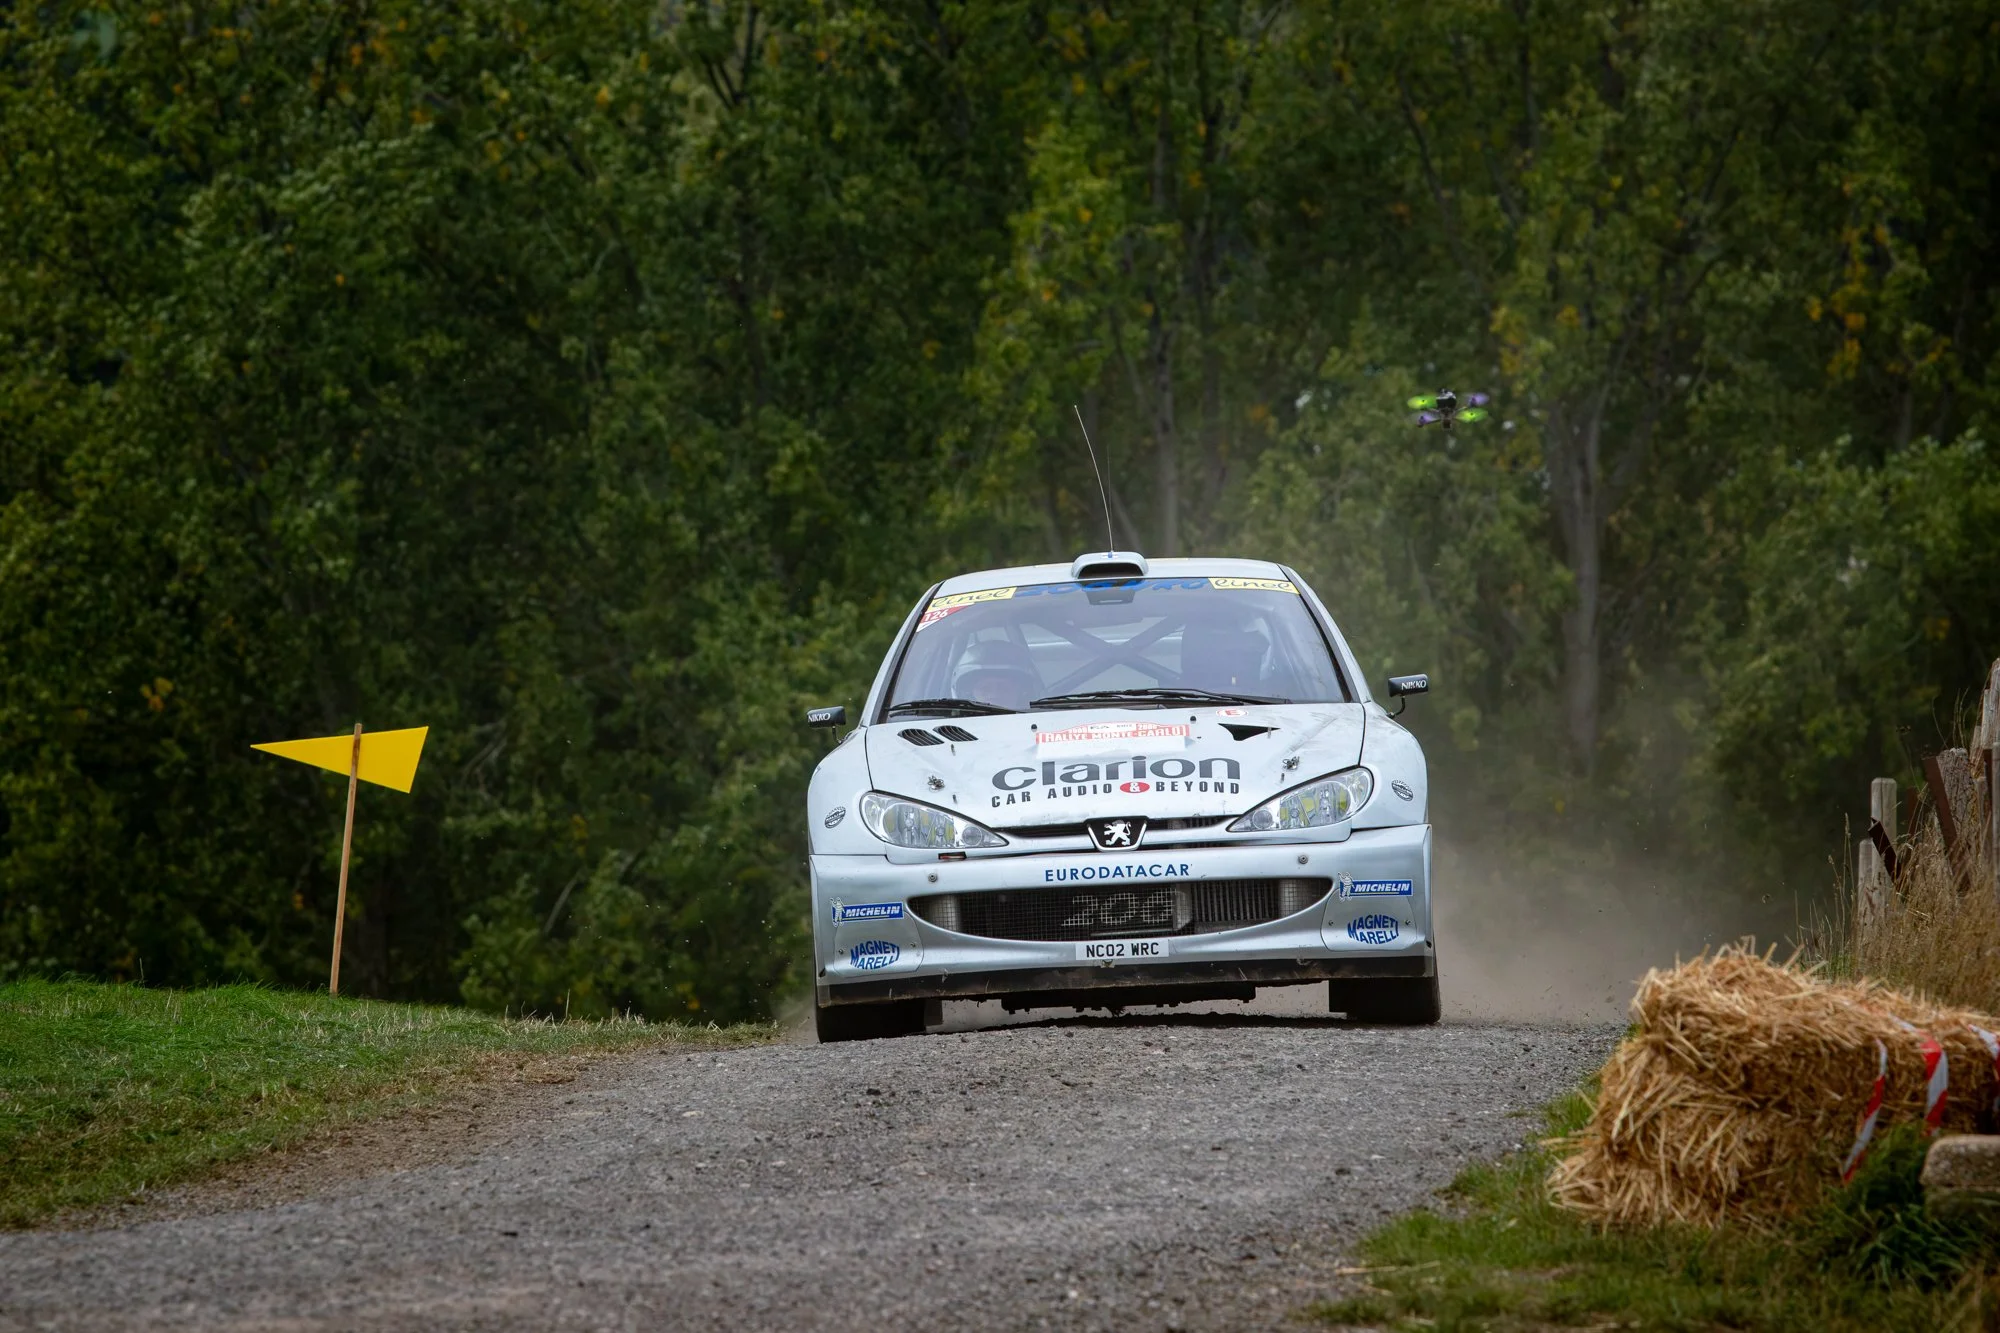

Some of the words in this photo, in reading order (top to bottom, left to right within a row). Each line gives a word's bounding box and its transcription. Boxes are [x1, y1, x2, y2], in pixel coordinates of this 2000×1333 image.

[924, 609, 949, 622] 126
[1401, 679, 1427, 691] NIKKO
[1045, 730, 1092, 743] RALLYE
[1092, 725, 1182, 740] MONTE-CARLO
[991, 755, 1241, 791] clarion
[991, 791, 1032, 808] CAR
[1047, 783, 1113, 799] AUDIO
[1155, 781, 1240, 795] BEYOND
[1045, 863, 1190, 882] EURODATACAR
[1354, 883, 1411, 892] MICHELIN
[845, 905, 901, 918] MICHELIN
[1086, 944, 1125, 958] NC02
[1131, 942, 1160, 956] WRC
